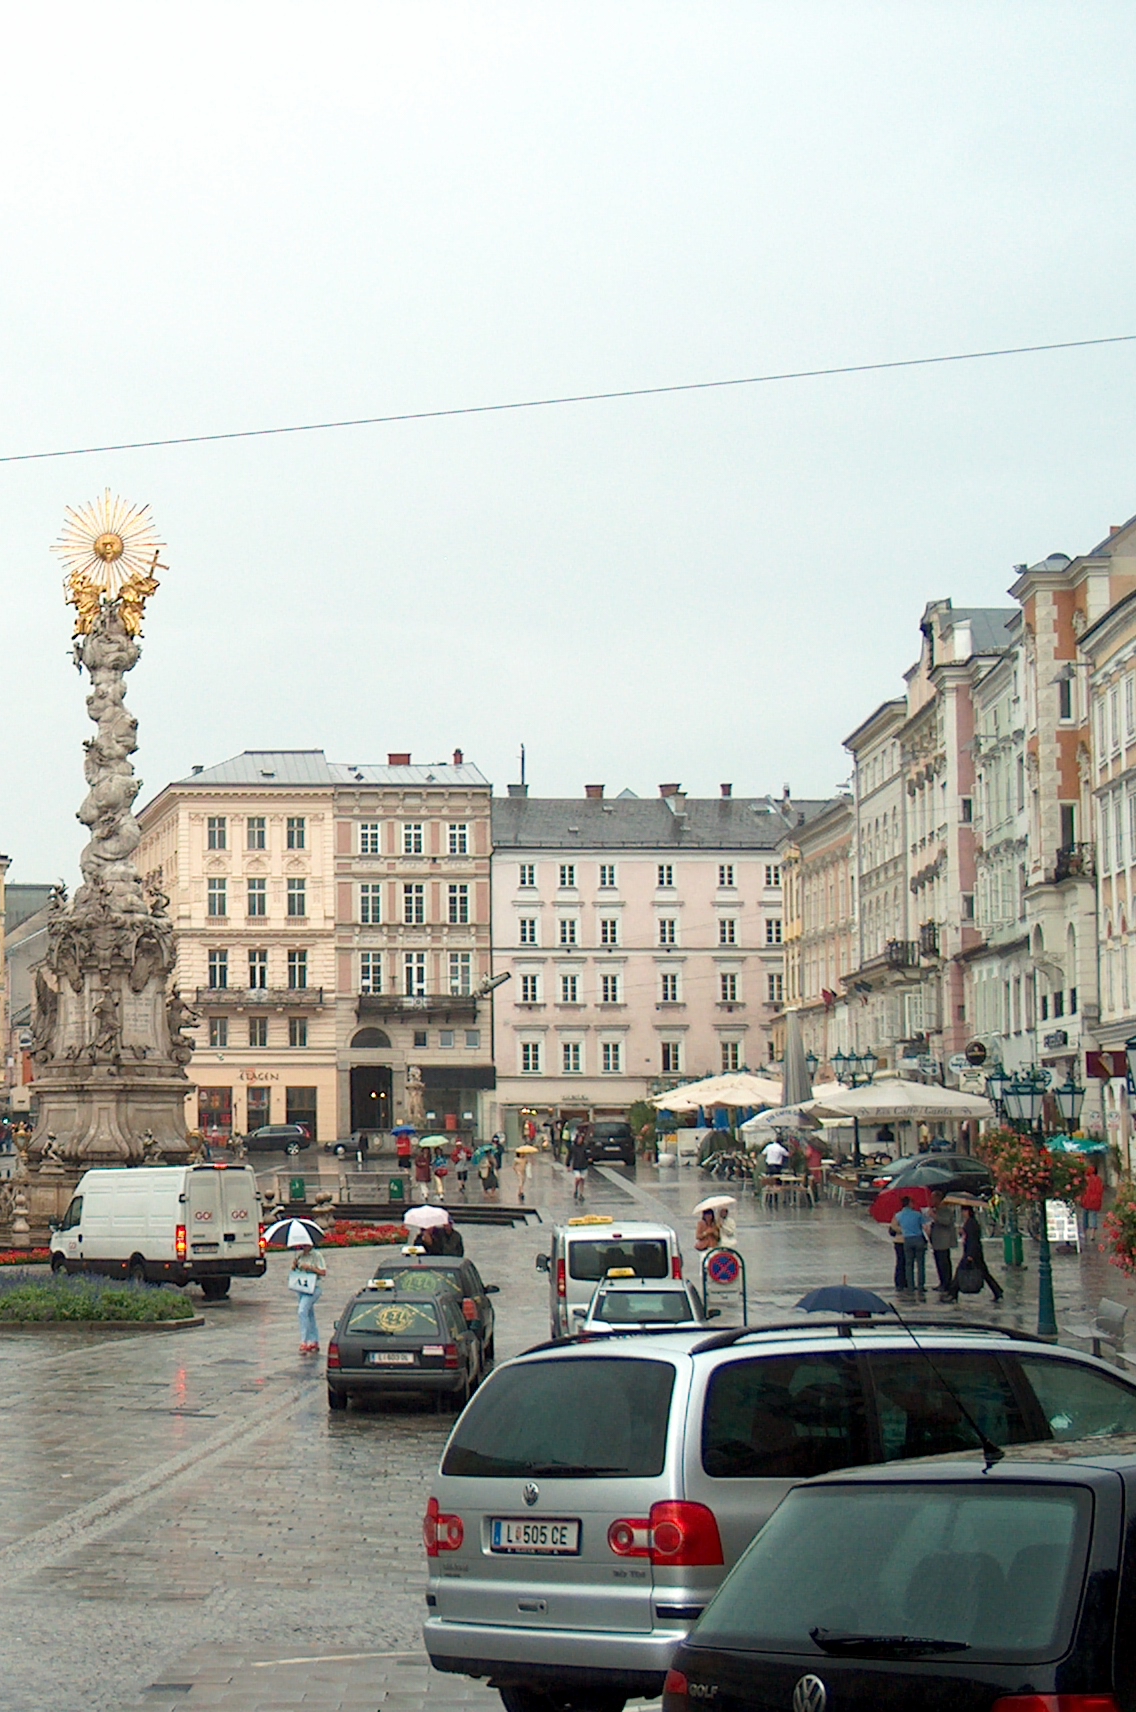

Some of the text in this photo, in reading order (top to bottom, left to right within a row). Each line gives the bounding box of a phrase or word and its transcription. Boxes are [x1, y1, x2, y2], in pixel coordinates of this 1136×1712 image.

[507, 1524, 568, 1545] L 505 CE
[689, 1683, 718, 1698] GOLF
